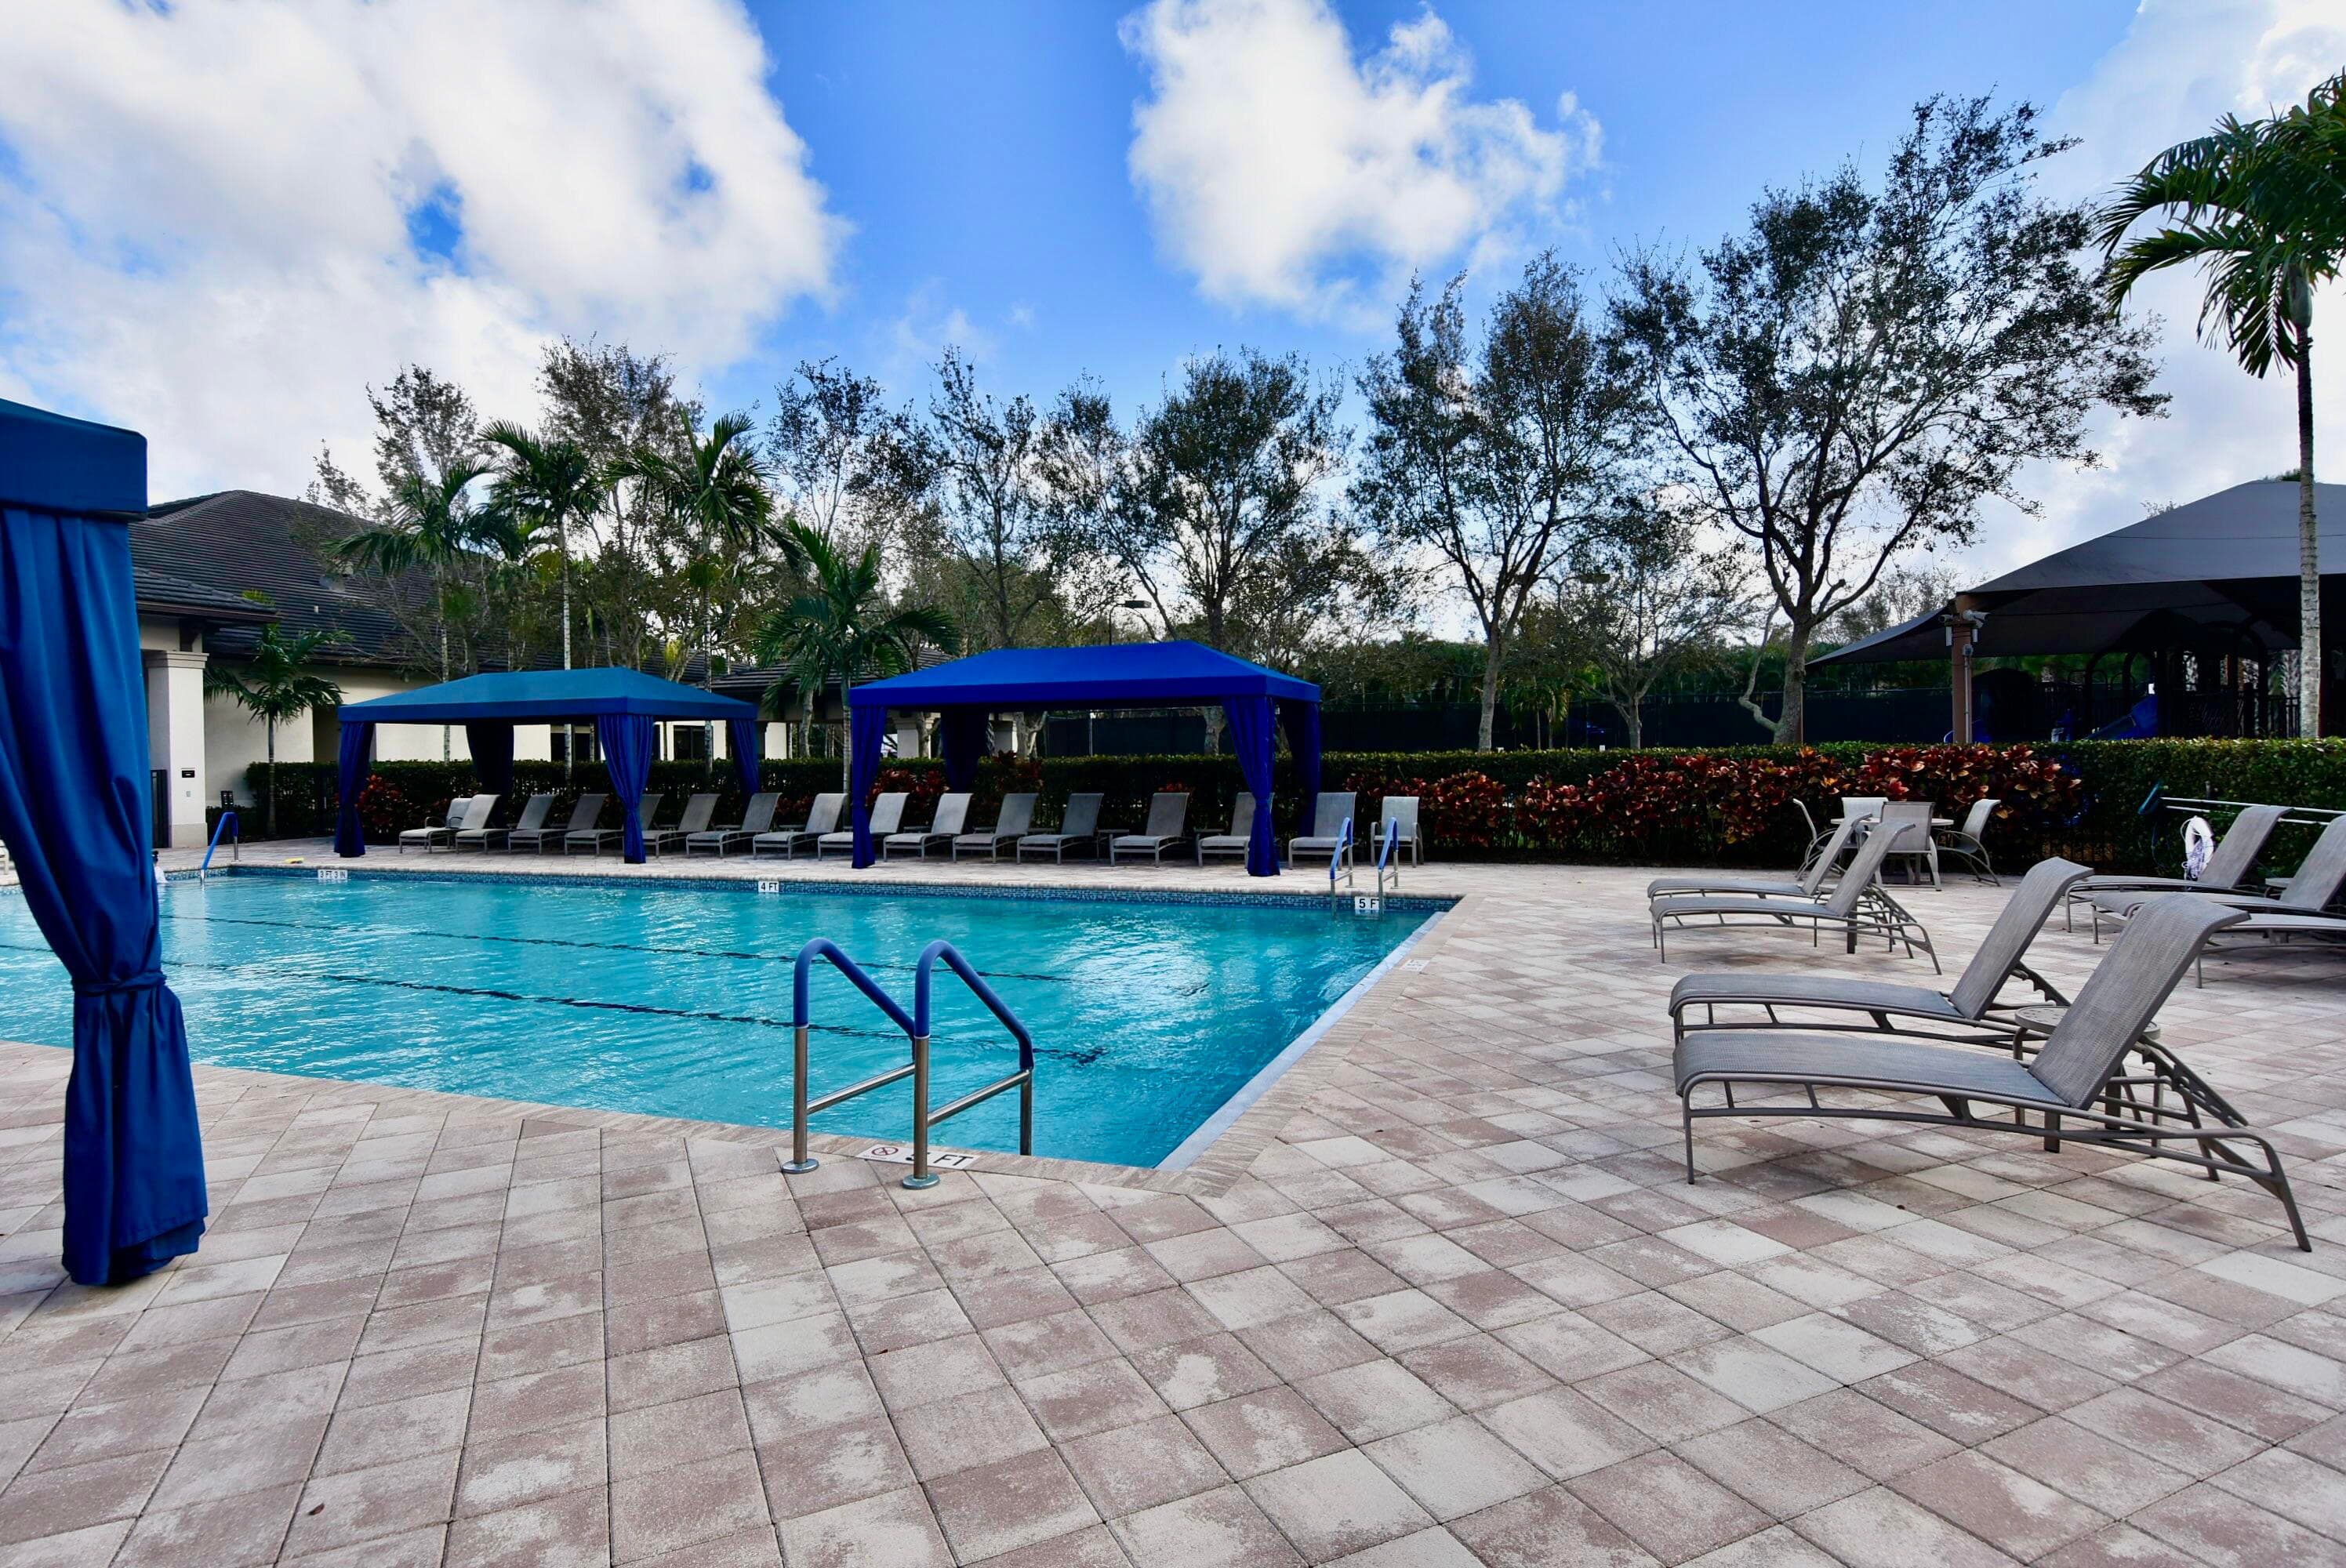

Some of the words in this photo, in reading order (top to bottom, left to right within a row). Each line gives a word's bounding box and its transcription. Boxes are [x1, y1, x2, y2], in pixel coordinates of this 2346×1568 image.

[761, 882, 766, 891] 4
[1359, 898, 1366, 909] 5
[933, 1154, 974, 1166] FT
